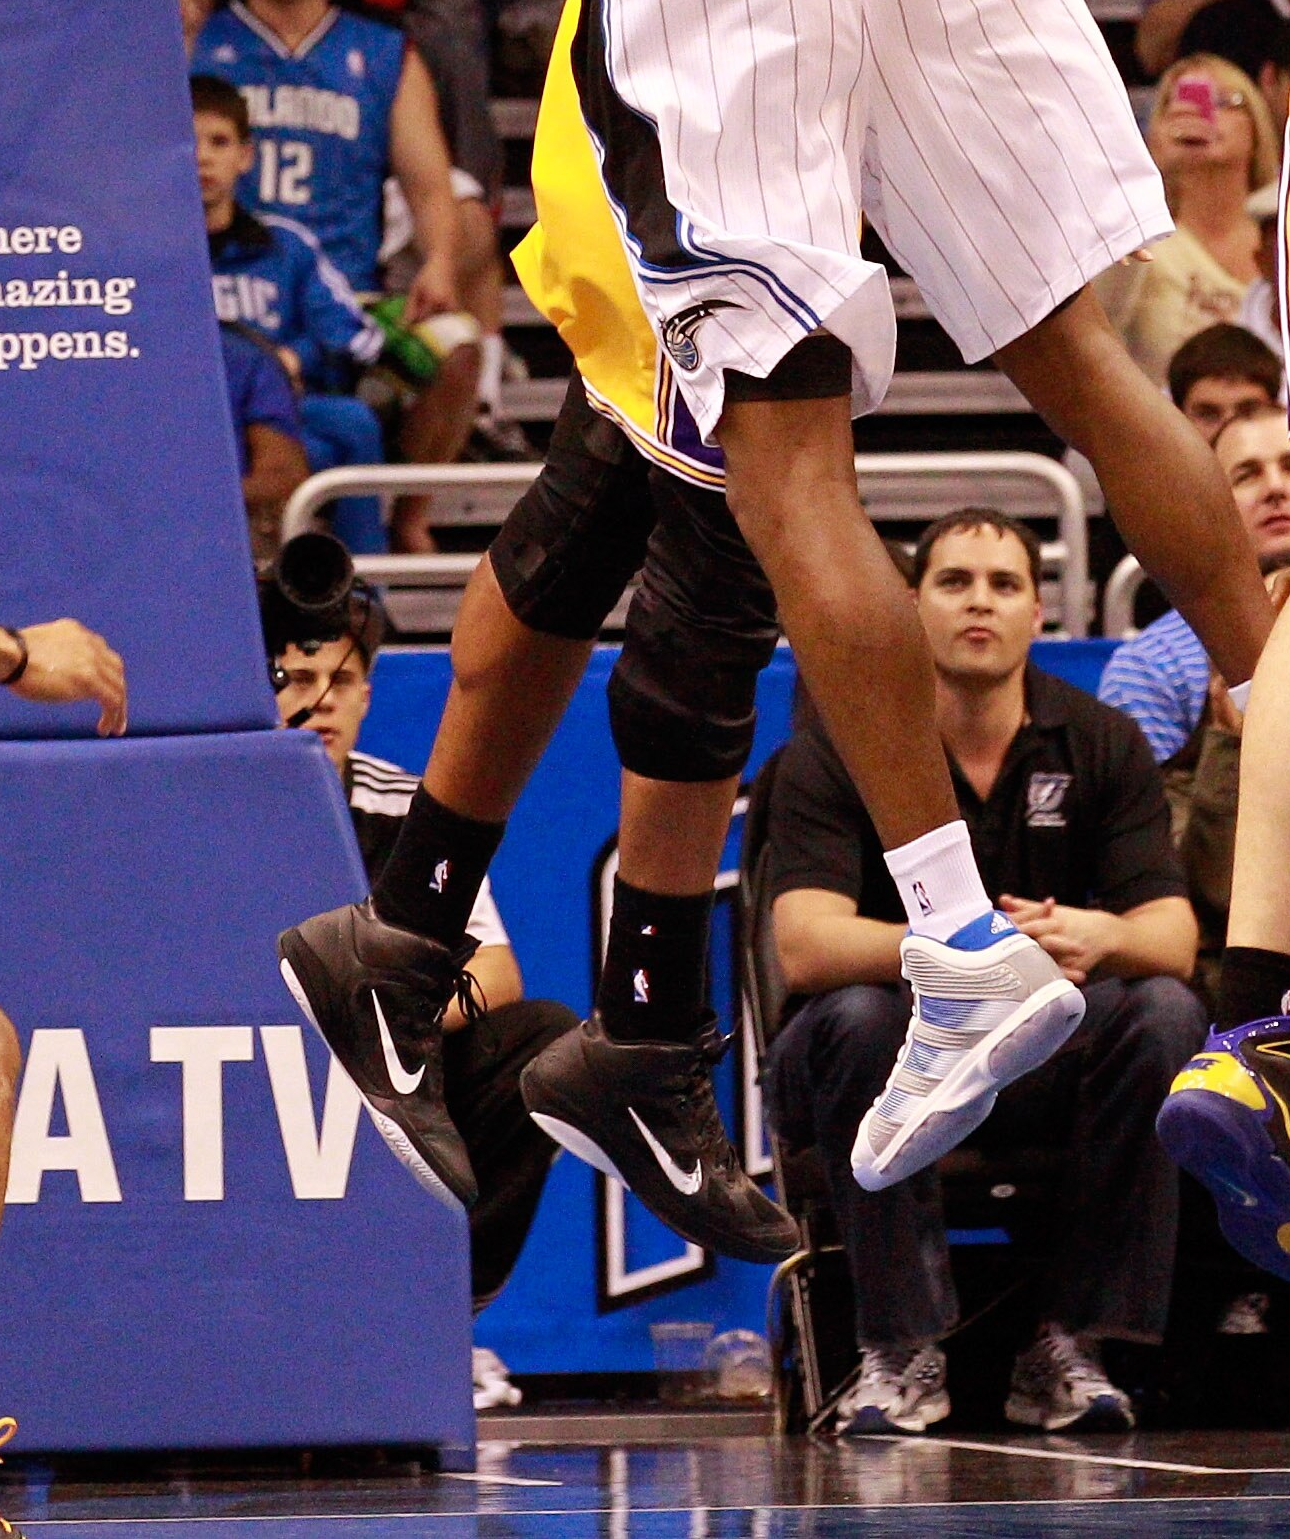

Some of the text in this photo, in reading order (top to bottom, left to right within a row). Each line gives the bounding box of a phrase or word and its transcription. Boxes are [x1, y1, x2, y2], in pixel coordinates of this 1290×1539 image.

[259, 139, 312, 205] 12
[211, 273, 282, 330] GIC
[150, 1025, 364, 1201] TV
